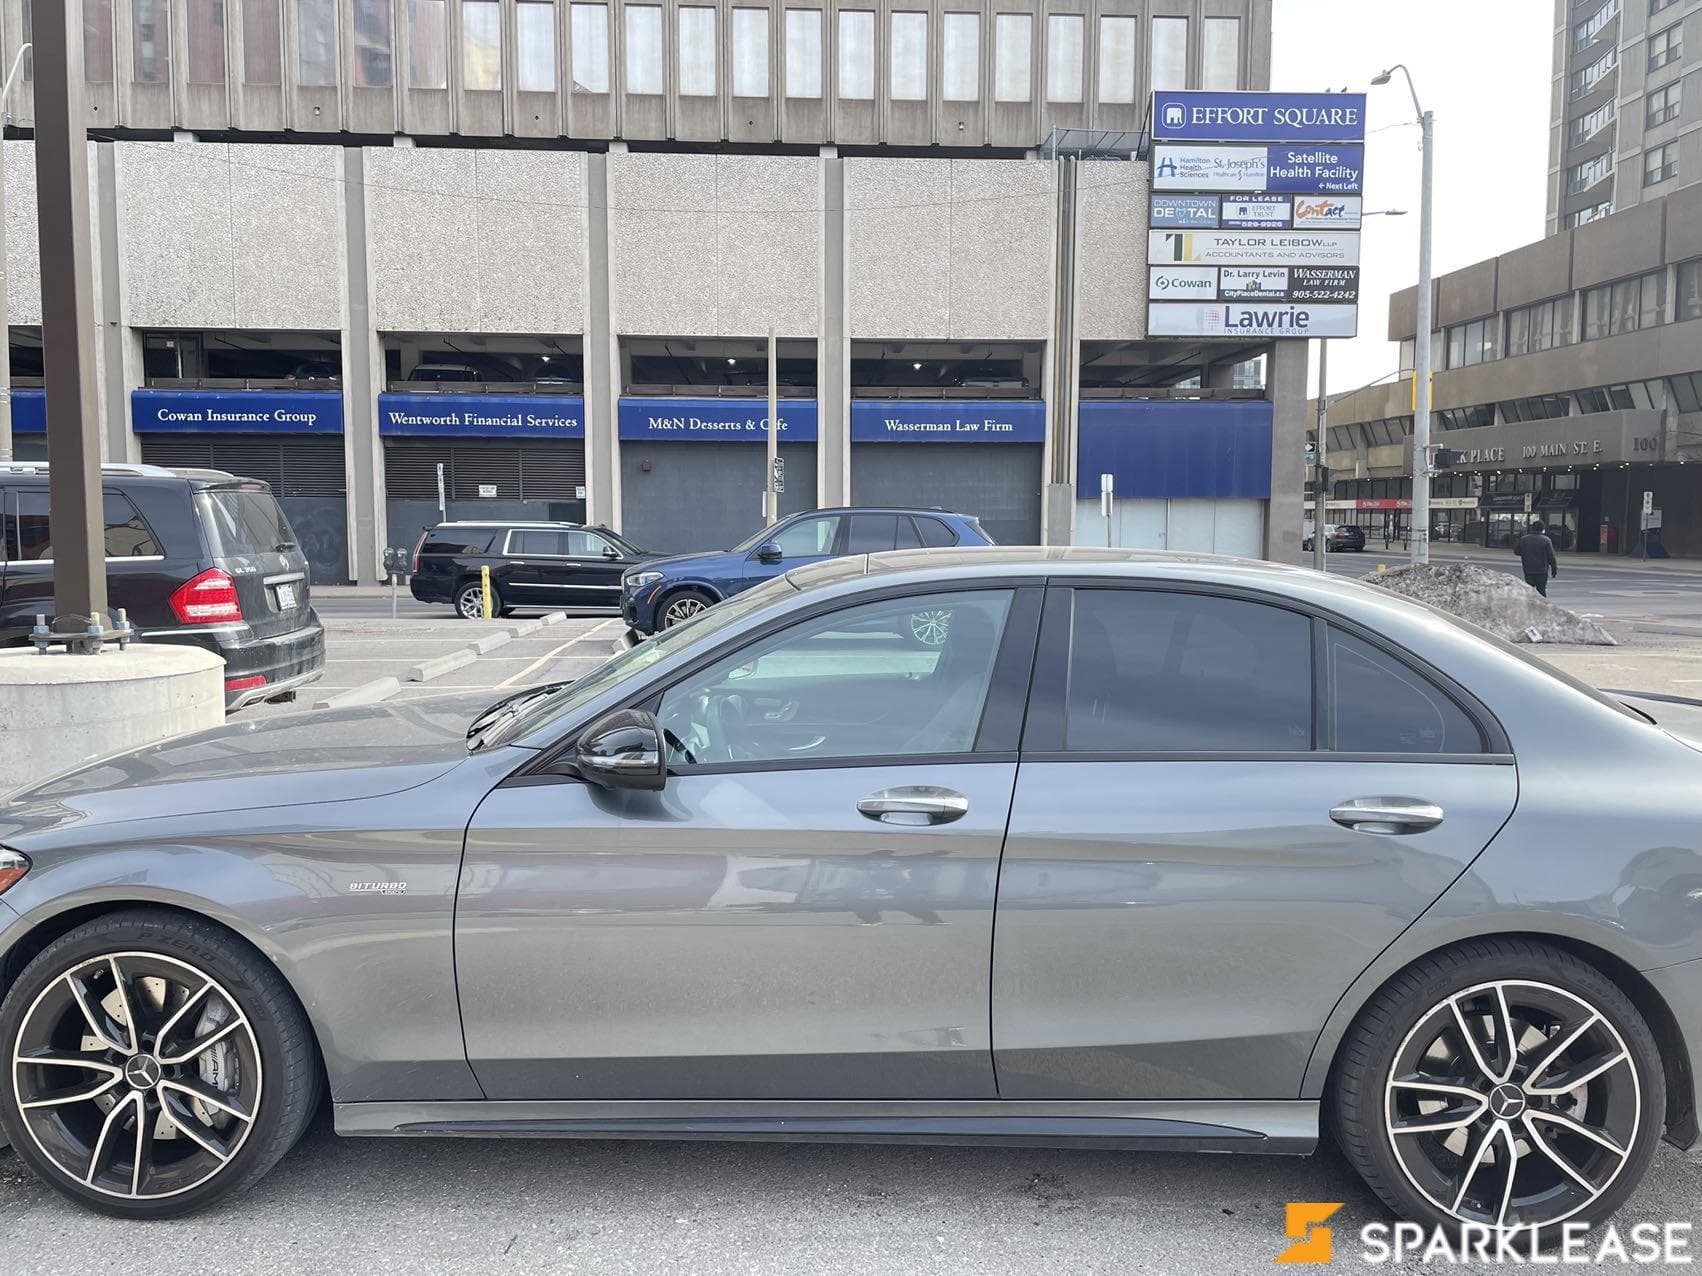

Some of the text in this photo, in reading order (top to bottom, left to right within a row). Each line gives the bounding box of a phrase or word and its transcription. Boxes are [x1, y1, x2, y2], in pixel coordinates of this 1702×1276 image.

[1191, 107, 1358, 128] EFFORT SQUARE
[1227, 158, 1266, 171] Joseph's
[1287, 152, 1338, 164] Satellite
[1270, 166, 1359, 182] Health Facility
[1325, 182, 1342, 190] Next
[1153, 199, 1216, 207] DOWNTOWN
[1295, 199, 1345, 219] Contact
[1214, 238, 1266, 247] TAYLOR
[1270, 238, 1323, 247] LEIBOW
[1223, 270, 1285, 279] Dr. Larry Levin
[1294, 268, 1356, 279] WASSERMAN
[1171, 277, 1212, 288] Cowan
[1224, 290, 1285, 298] CityPlaceDental.ca
[1292, 290, 1355, 299] 905-522-4242
[1224, 305, 1310, 328] Lawrie
[157, 408, 317, 425] Cowan Insurance Group
[388, 412, 577, 427] Wentworth Financial Services
[648, 417, 788, 431] M&N Desserts & Cfe
[884, 419, 1013, 432] Wasserman Law Firm
[1633, 437, 1659, 451] 100
[1470, 447, 1504, 463] PLACE
[1522, 445, 1536, 459] 100
[1540, 443, 1567, 458] MAIN
